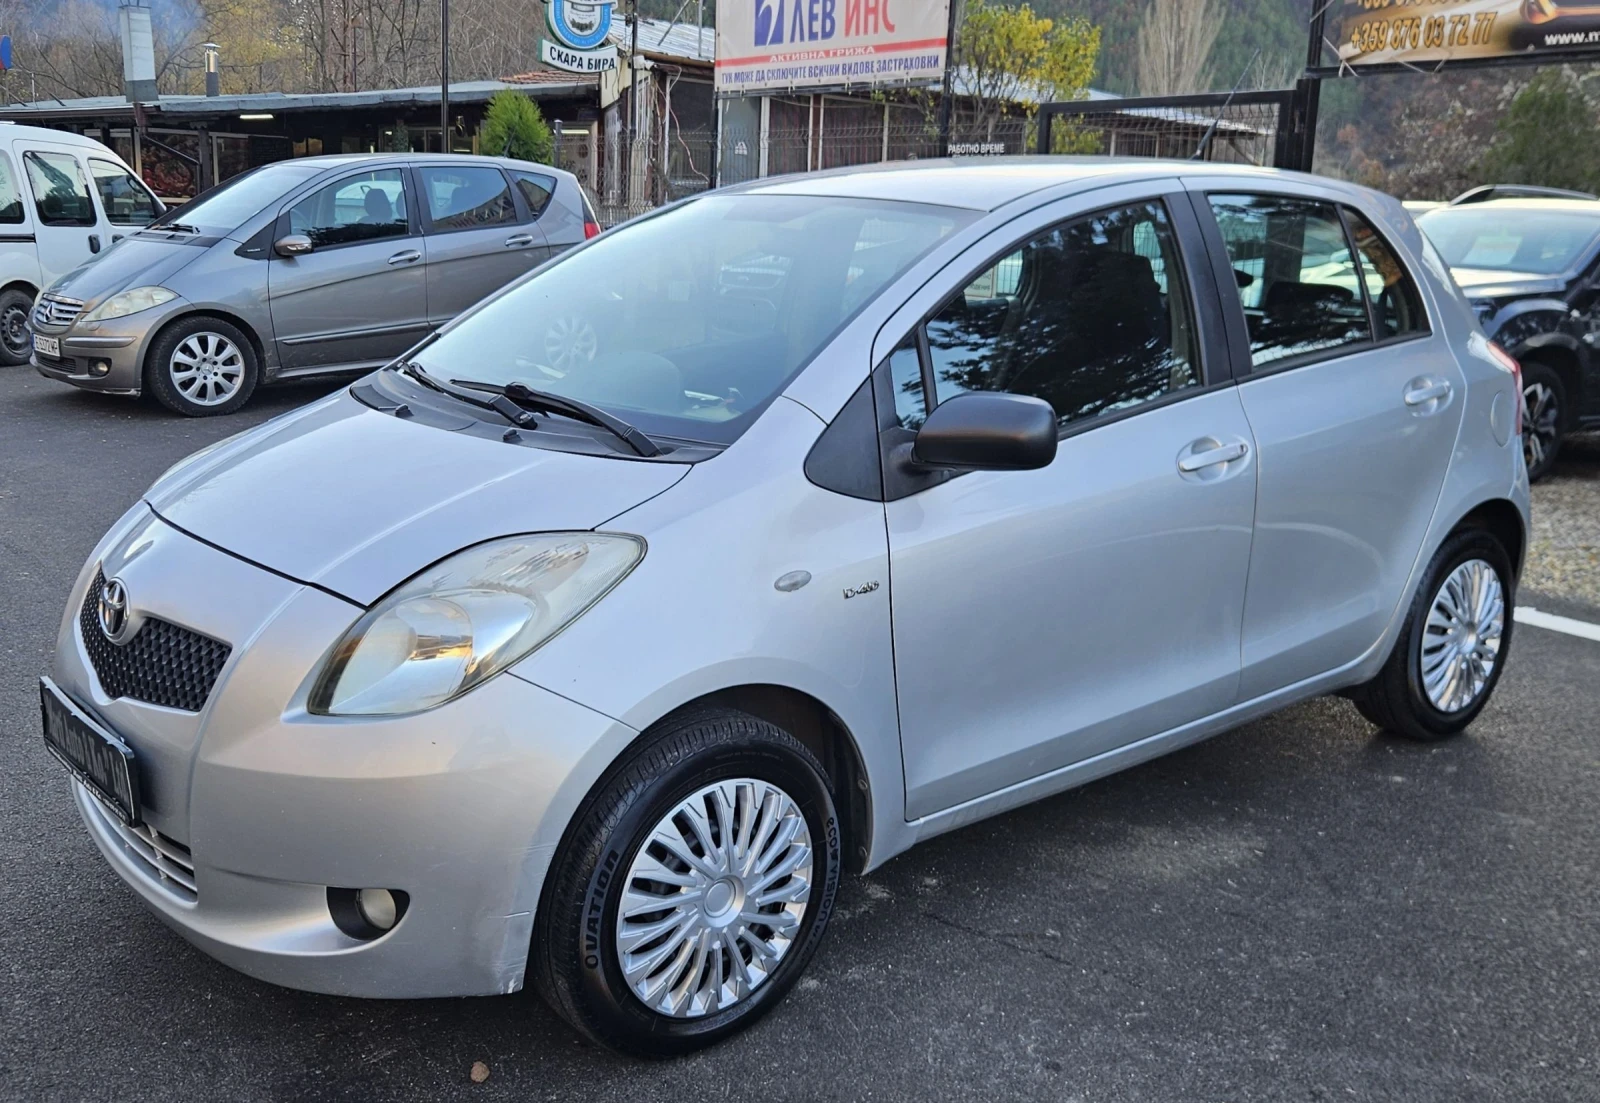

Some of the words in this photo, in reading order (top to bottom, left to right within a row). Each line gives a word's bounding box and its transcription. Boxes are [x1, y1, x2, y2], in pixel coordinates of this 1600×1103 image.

[789, 0, 836, 43] ЛЕВ
[844, 0, 895, 38] ИНС
[1351, 21, 1389, 52] +359
[1390, 17, 1421, 49] 876
[1423, 16, 1445, 48] 03
[1447, 14, 1470, 46] 72
[1472, 11, 1498, 45] 77
[549, 46, 583, 70] СКАРА
[587, 58, 615, 70] БИРА
[769, 51, 826, 63] АКТИВНА
[829, 46, 875, 58] ГРИЖА
[722, 73, 733, 84] ТУК
[734, 70, 754, 83] МОЖЕ
[755, 69, 765, 83] ДА
[767, 66, 806, 81] СКЛЮЧИТЕ
[808, 63, 840, 78] ВСИЧКИ
[841, 60, 875, 76] ВИДОВЕ
[876, 55, 939, 73] ЗАСТРАХОВКИ
[947, 144, 979, 154] РАБОТНО
[981, 143, 1004, 154] ВРЕМЕ
